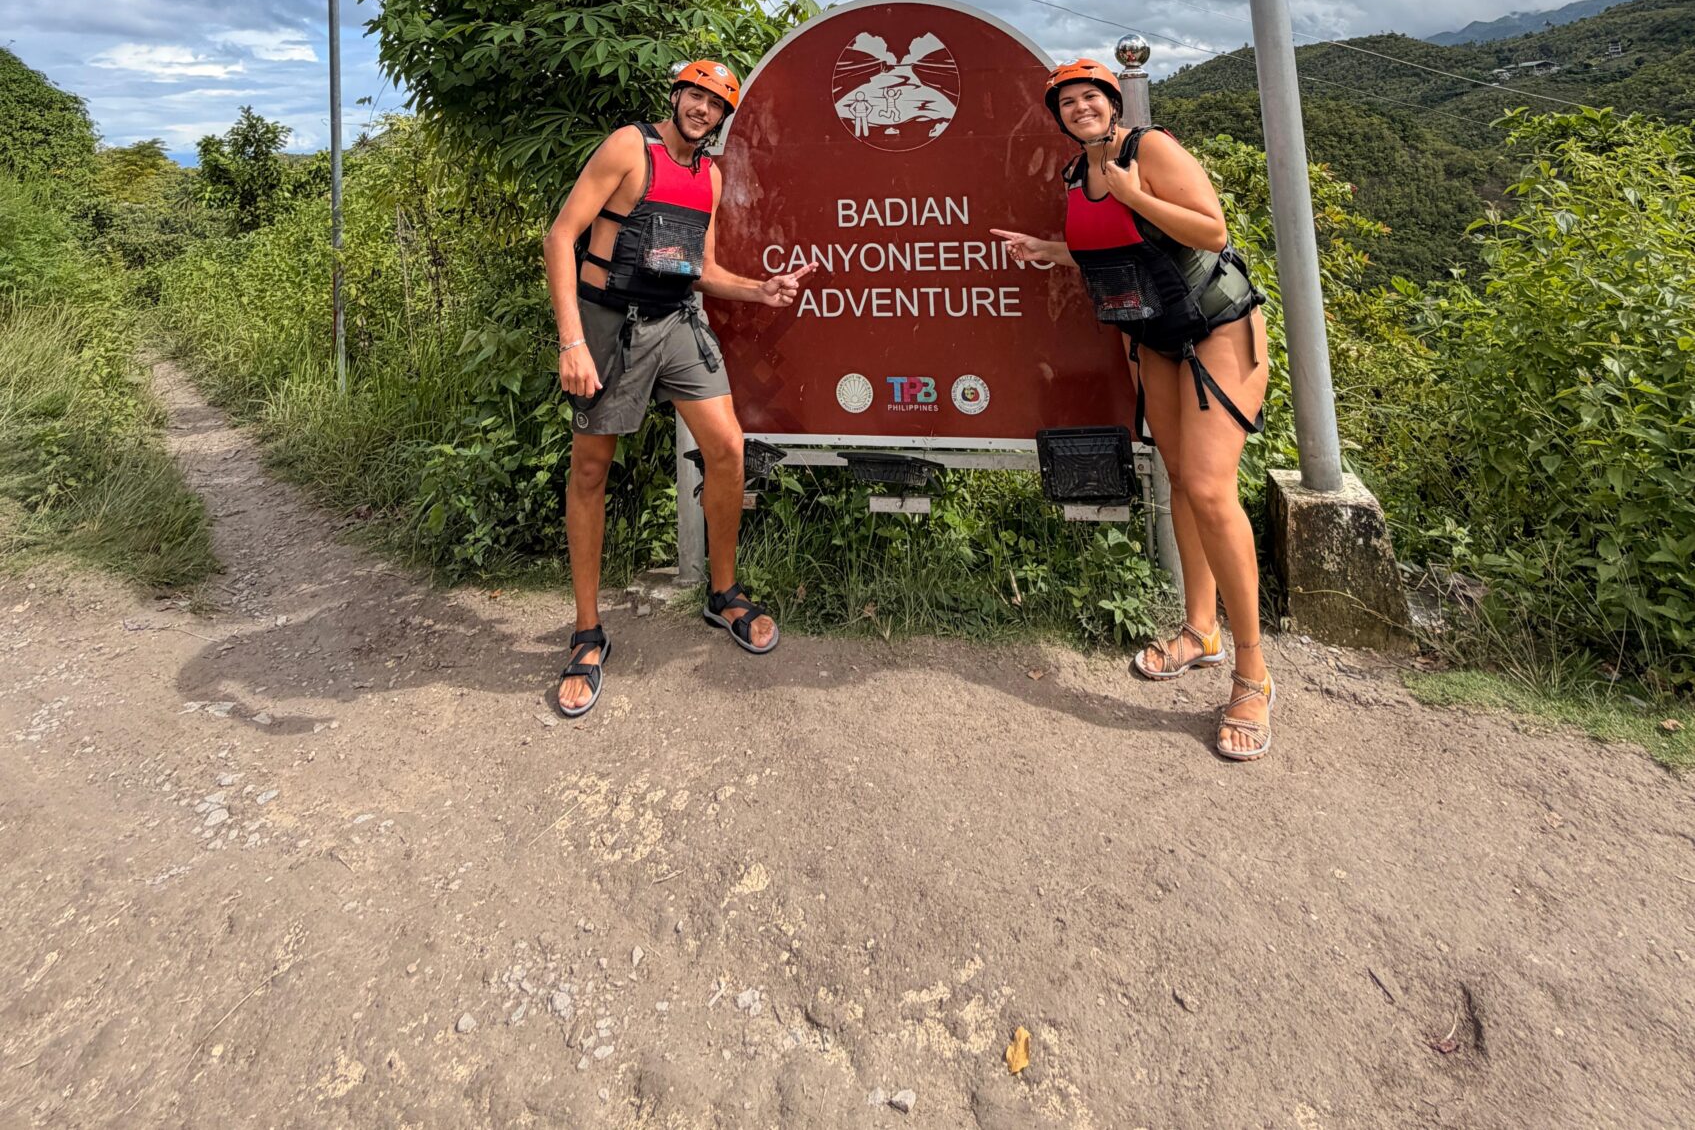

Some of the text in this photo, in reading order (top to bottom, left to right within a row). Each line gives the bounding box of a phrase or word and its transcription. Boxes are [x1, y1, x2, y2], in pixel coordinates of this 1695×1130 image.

[838, 197, 969, 227] BADIAN
[763, 241, 1056, 273] CANYONEERIN
[797, 287, 1022, 318] ADVENTURE
[887, 377, 937, 403] TPB
[888, 404, 939, 412] PHILIPPINES
